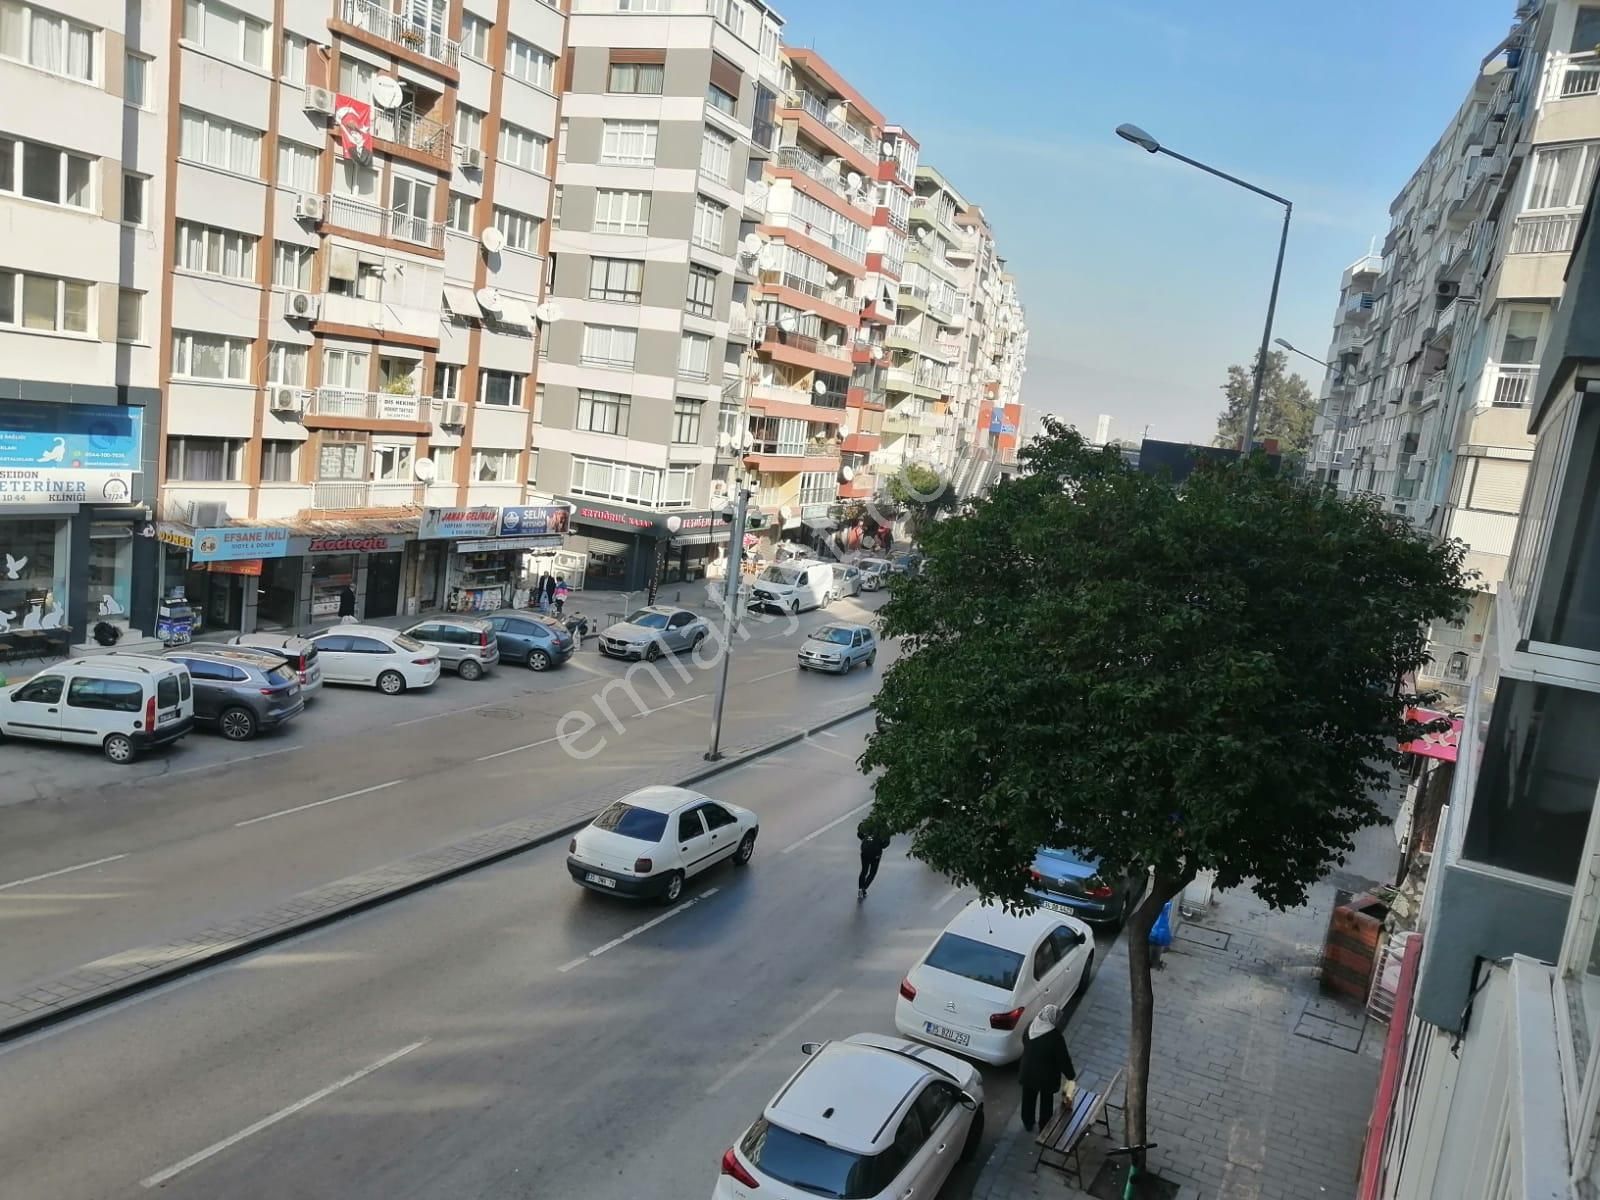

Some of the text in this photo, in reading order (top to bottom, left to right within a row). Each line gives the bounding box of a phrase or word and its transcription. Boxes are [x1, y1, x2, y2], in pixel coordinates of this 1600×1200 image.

[523, 507, 547, 520] SELİN
[224, 528, 286, 543] EFSANE İKİLİ
[955, 1032, 968, 1043] 252
